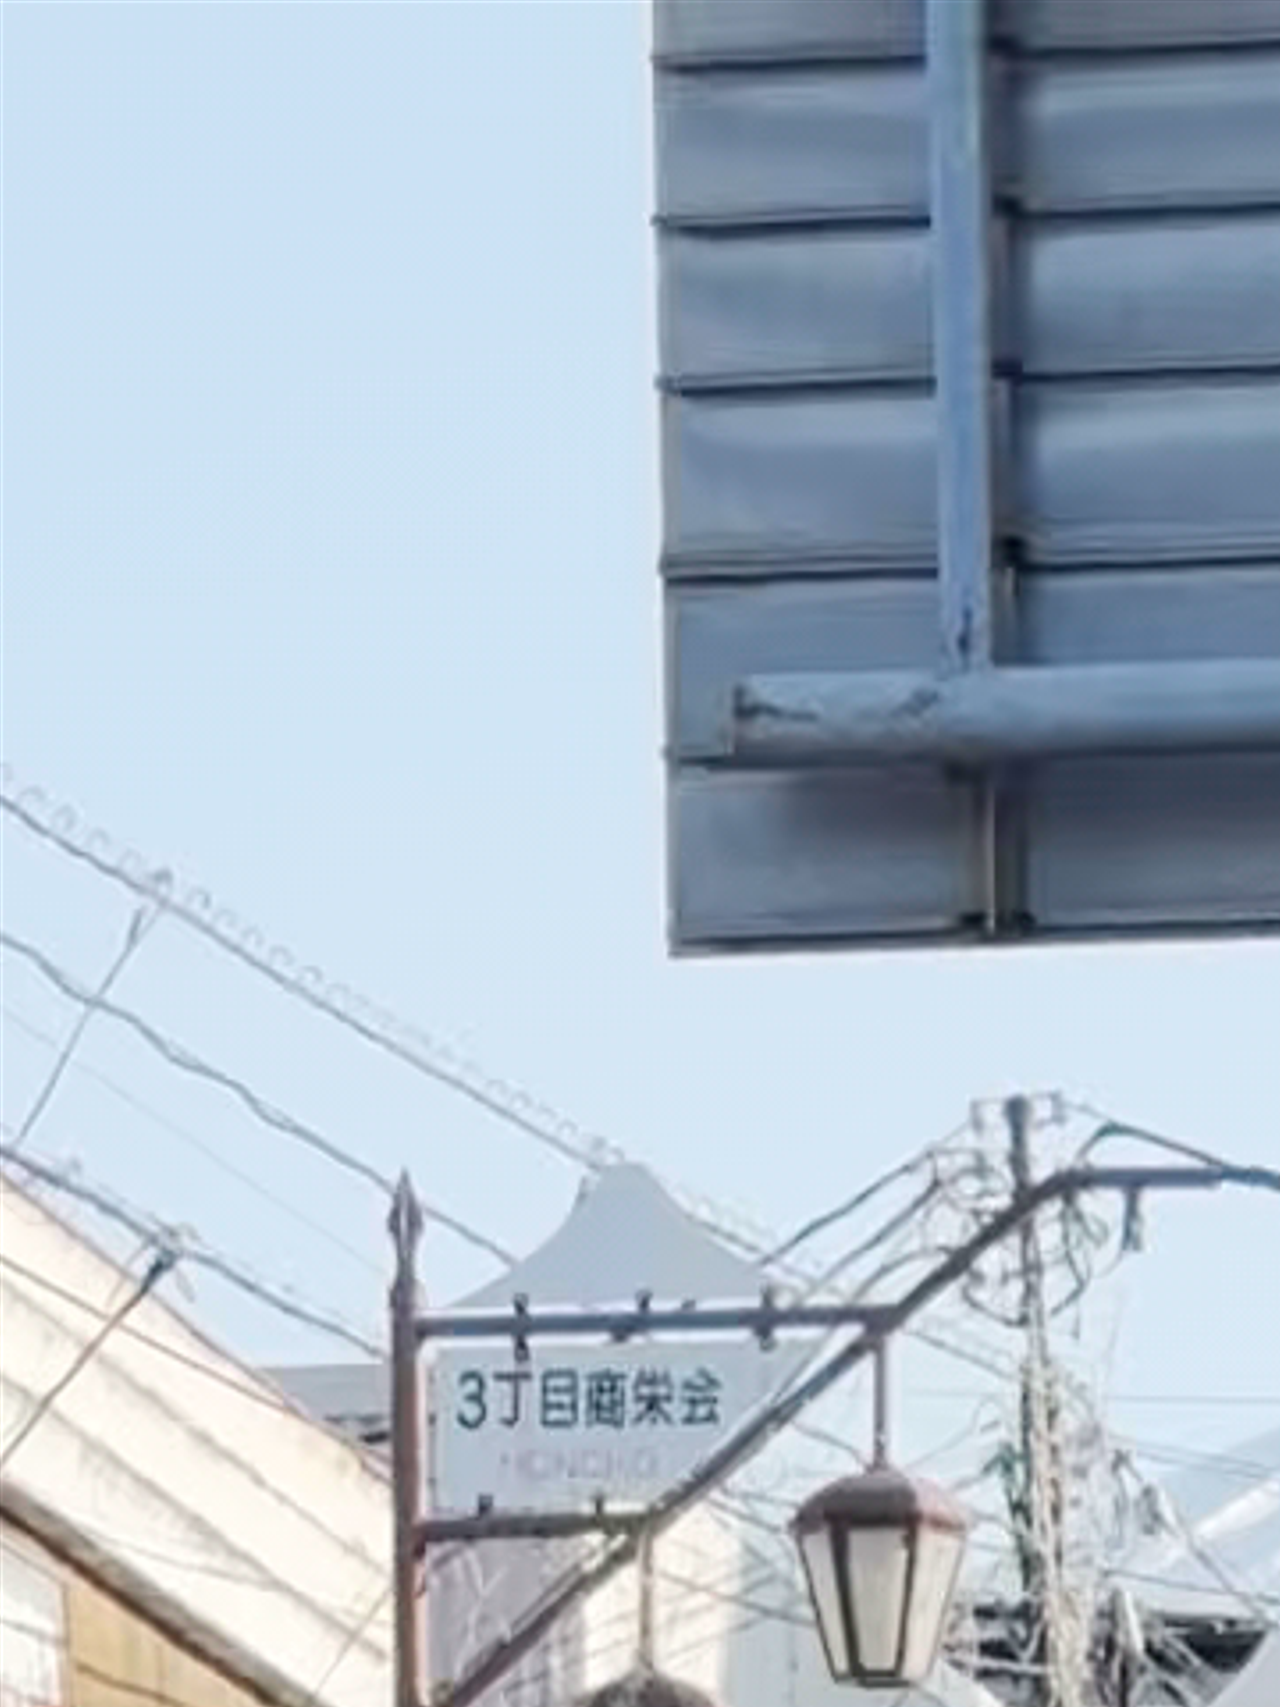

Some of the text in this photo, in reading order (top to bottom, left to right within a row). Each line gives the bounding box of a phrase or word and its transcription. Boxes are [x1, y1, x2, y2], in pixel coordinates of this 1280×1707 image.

[457, 1367, 723, 1430] 3丁目商栄会
